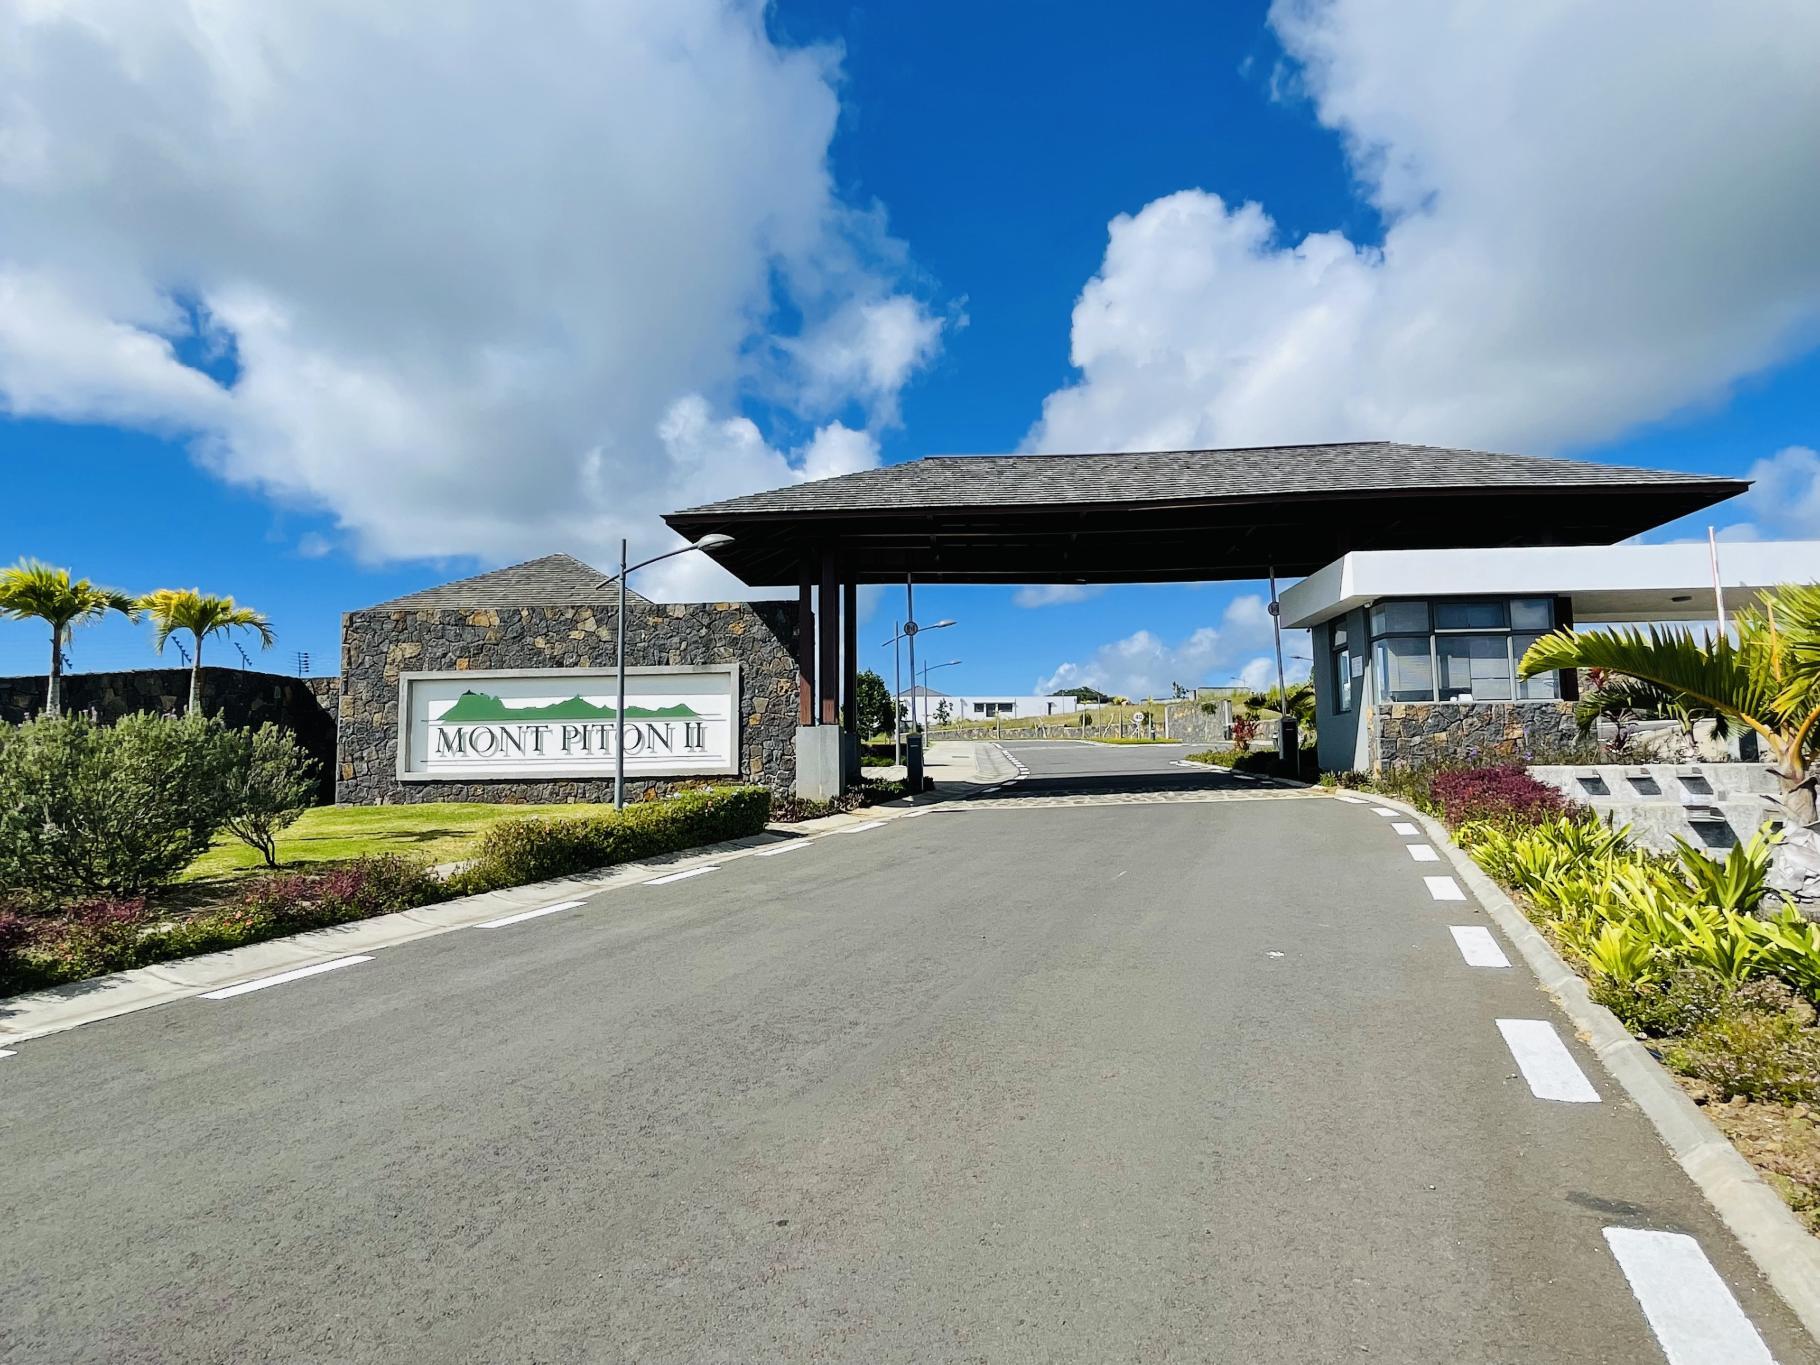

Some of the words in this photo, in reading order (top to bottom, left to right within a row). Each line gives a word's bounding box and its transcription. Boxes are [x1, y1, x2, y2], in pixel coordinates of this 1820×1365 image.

[435, 725, 549, 753] MONT
[560, 723, 674, 751] PITON
[684, 721, 703, 748] II
